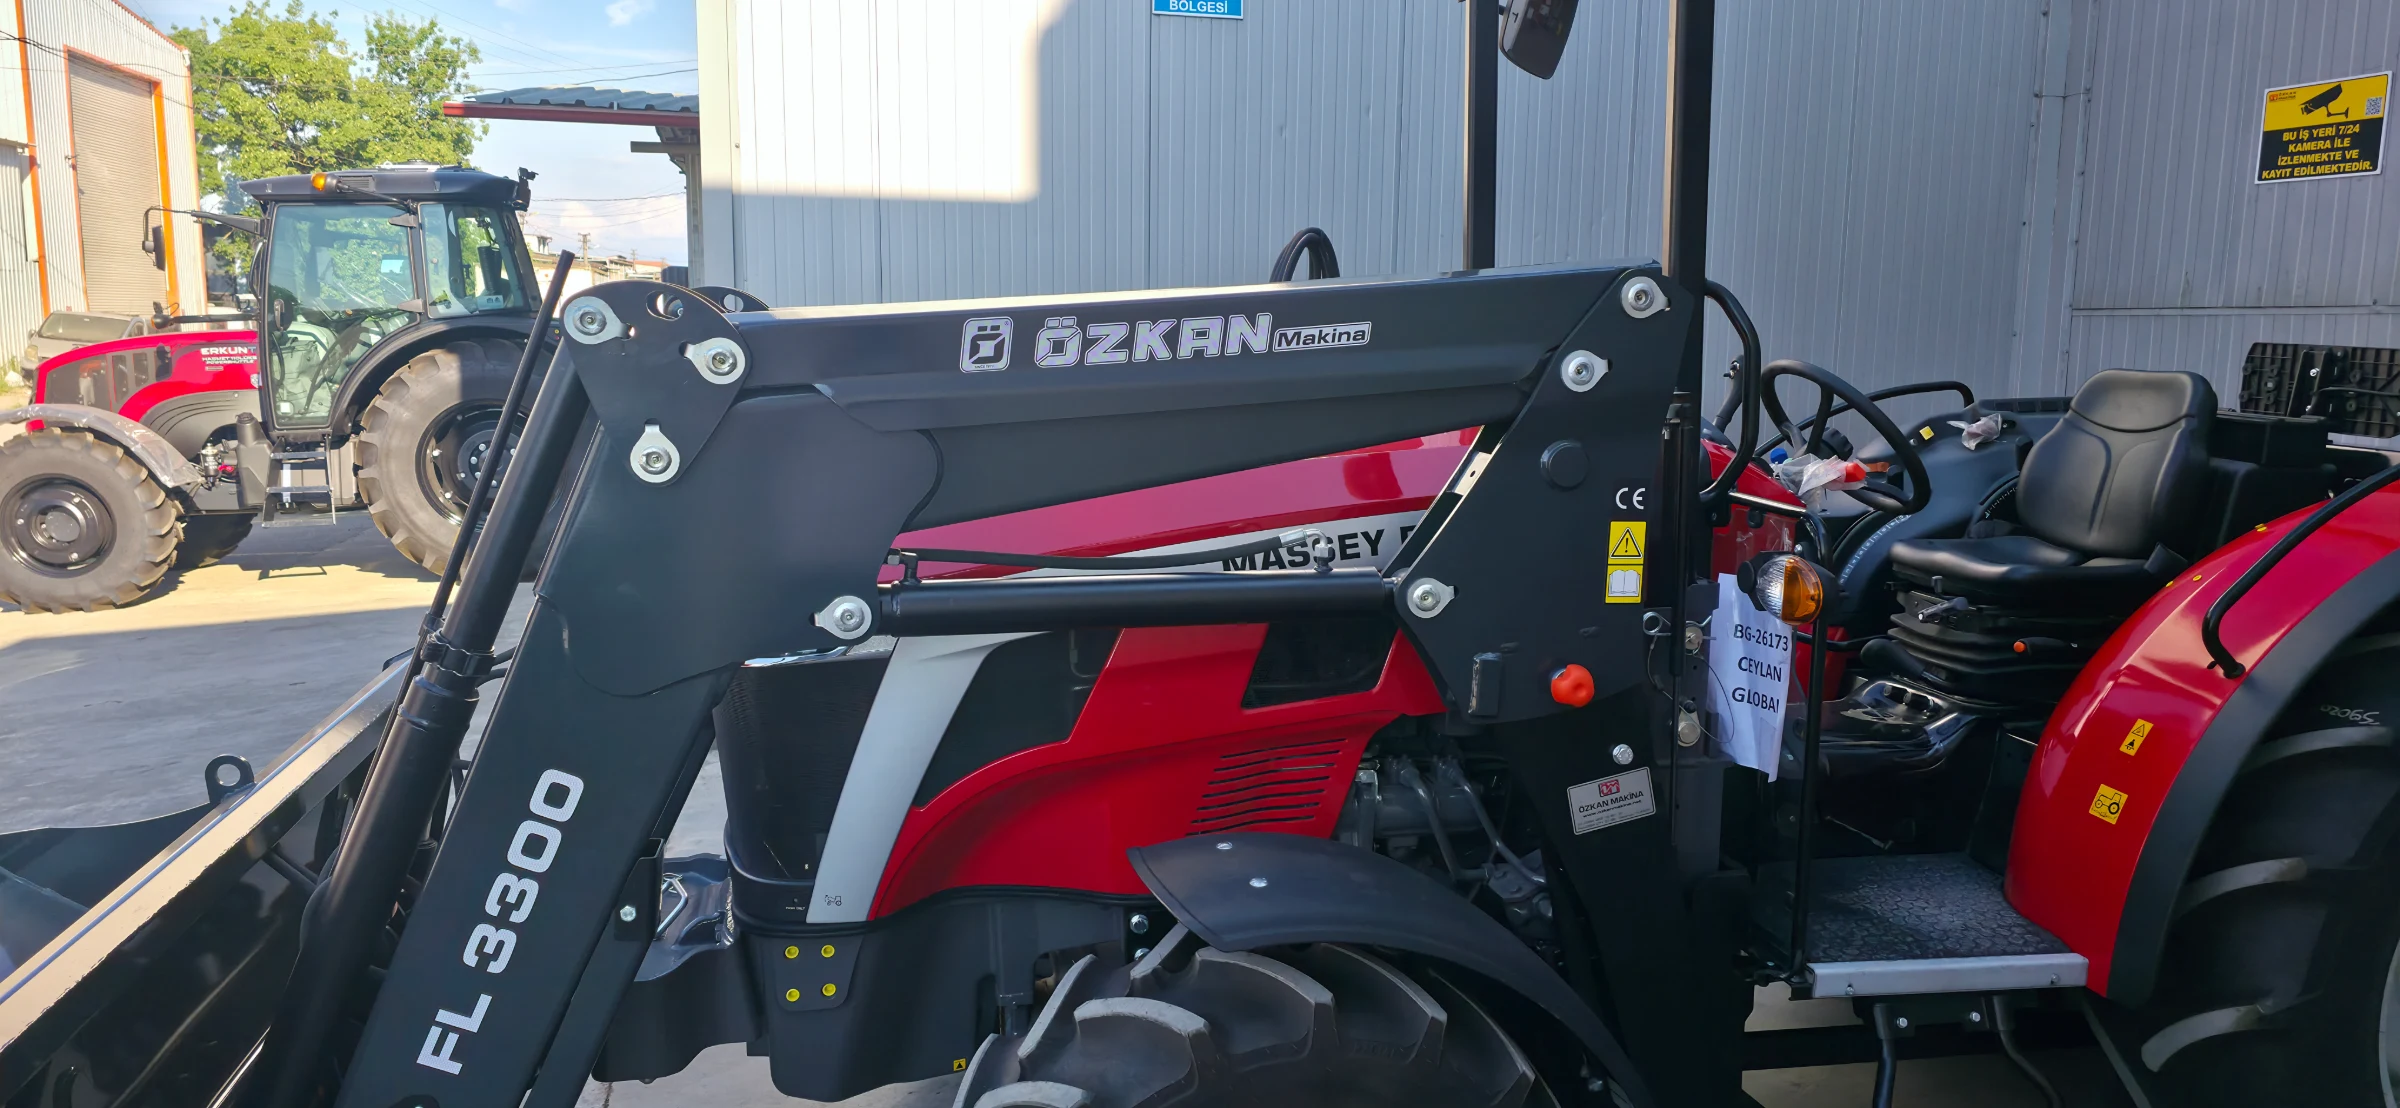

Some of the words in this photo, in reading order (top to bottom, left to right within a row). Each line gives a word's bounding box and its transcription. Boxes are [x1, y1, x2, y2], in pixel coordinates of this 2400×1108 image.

[2282, 132, 2297, 141] BU
[2299, 129, 2309, 140] İŞ
[2312, 125, 2336, 138] YERİ
[2338, 124, 2360, 135] 7/24
[2288, 140, 2331, 153] KAMERA
[2334, 137, 2351, 148] İLE
[2277, 151, 2342, 166] İZLENMEKTE
[2345, 149, 2359, 159] VE
[2262, 168, 2292, 179] KAYIT
[1035, 312, 1272, 368] ÖZKAN
[1276, 329, 1367, 349] Makina
[1733, 623, 1789, 652] BG-26173
[1737, 656, 1782, 683] CEYLAN
[416, 993, 493, 1075] FL
[462, 768, 585, 974] 3300
